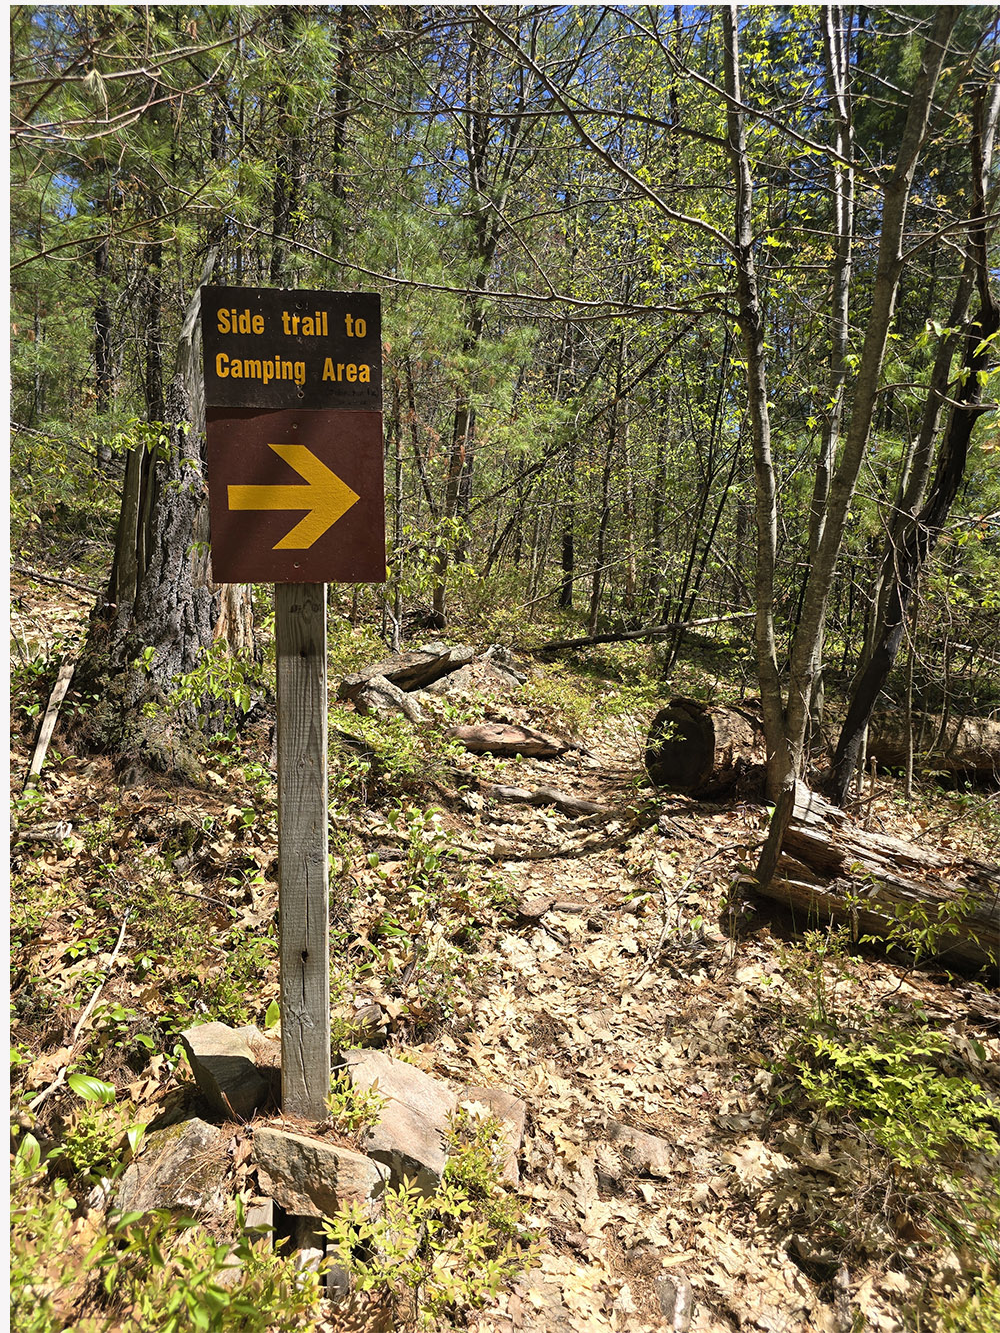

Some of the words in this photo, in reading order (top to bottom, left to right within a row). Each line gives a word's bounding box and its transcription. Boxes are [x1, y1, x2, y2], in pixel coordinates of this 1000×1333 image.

[217, 308, 265, 335] Side
[282, 311, 328, 337] trail
[345, 313, 367, 338] to
[215, 352, 306, 385] Camping
[322, 357, 371, 383] Area
